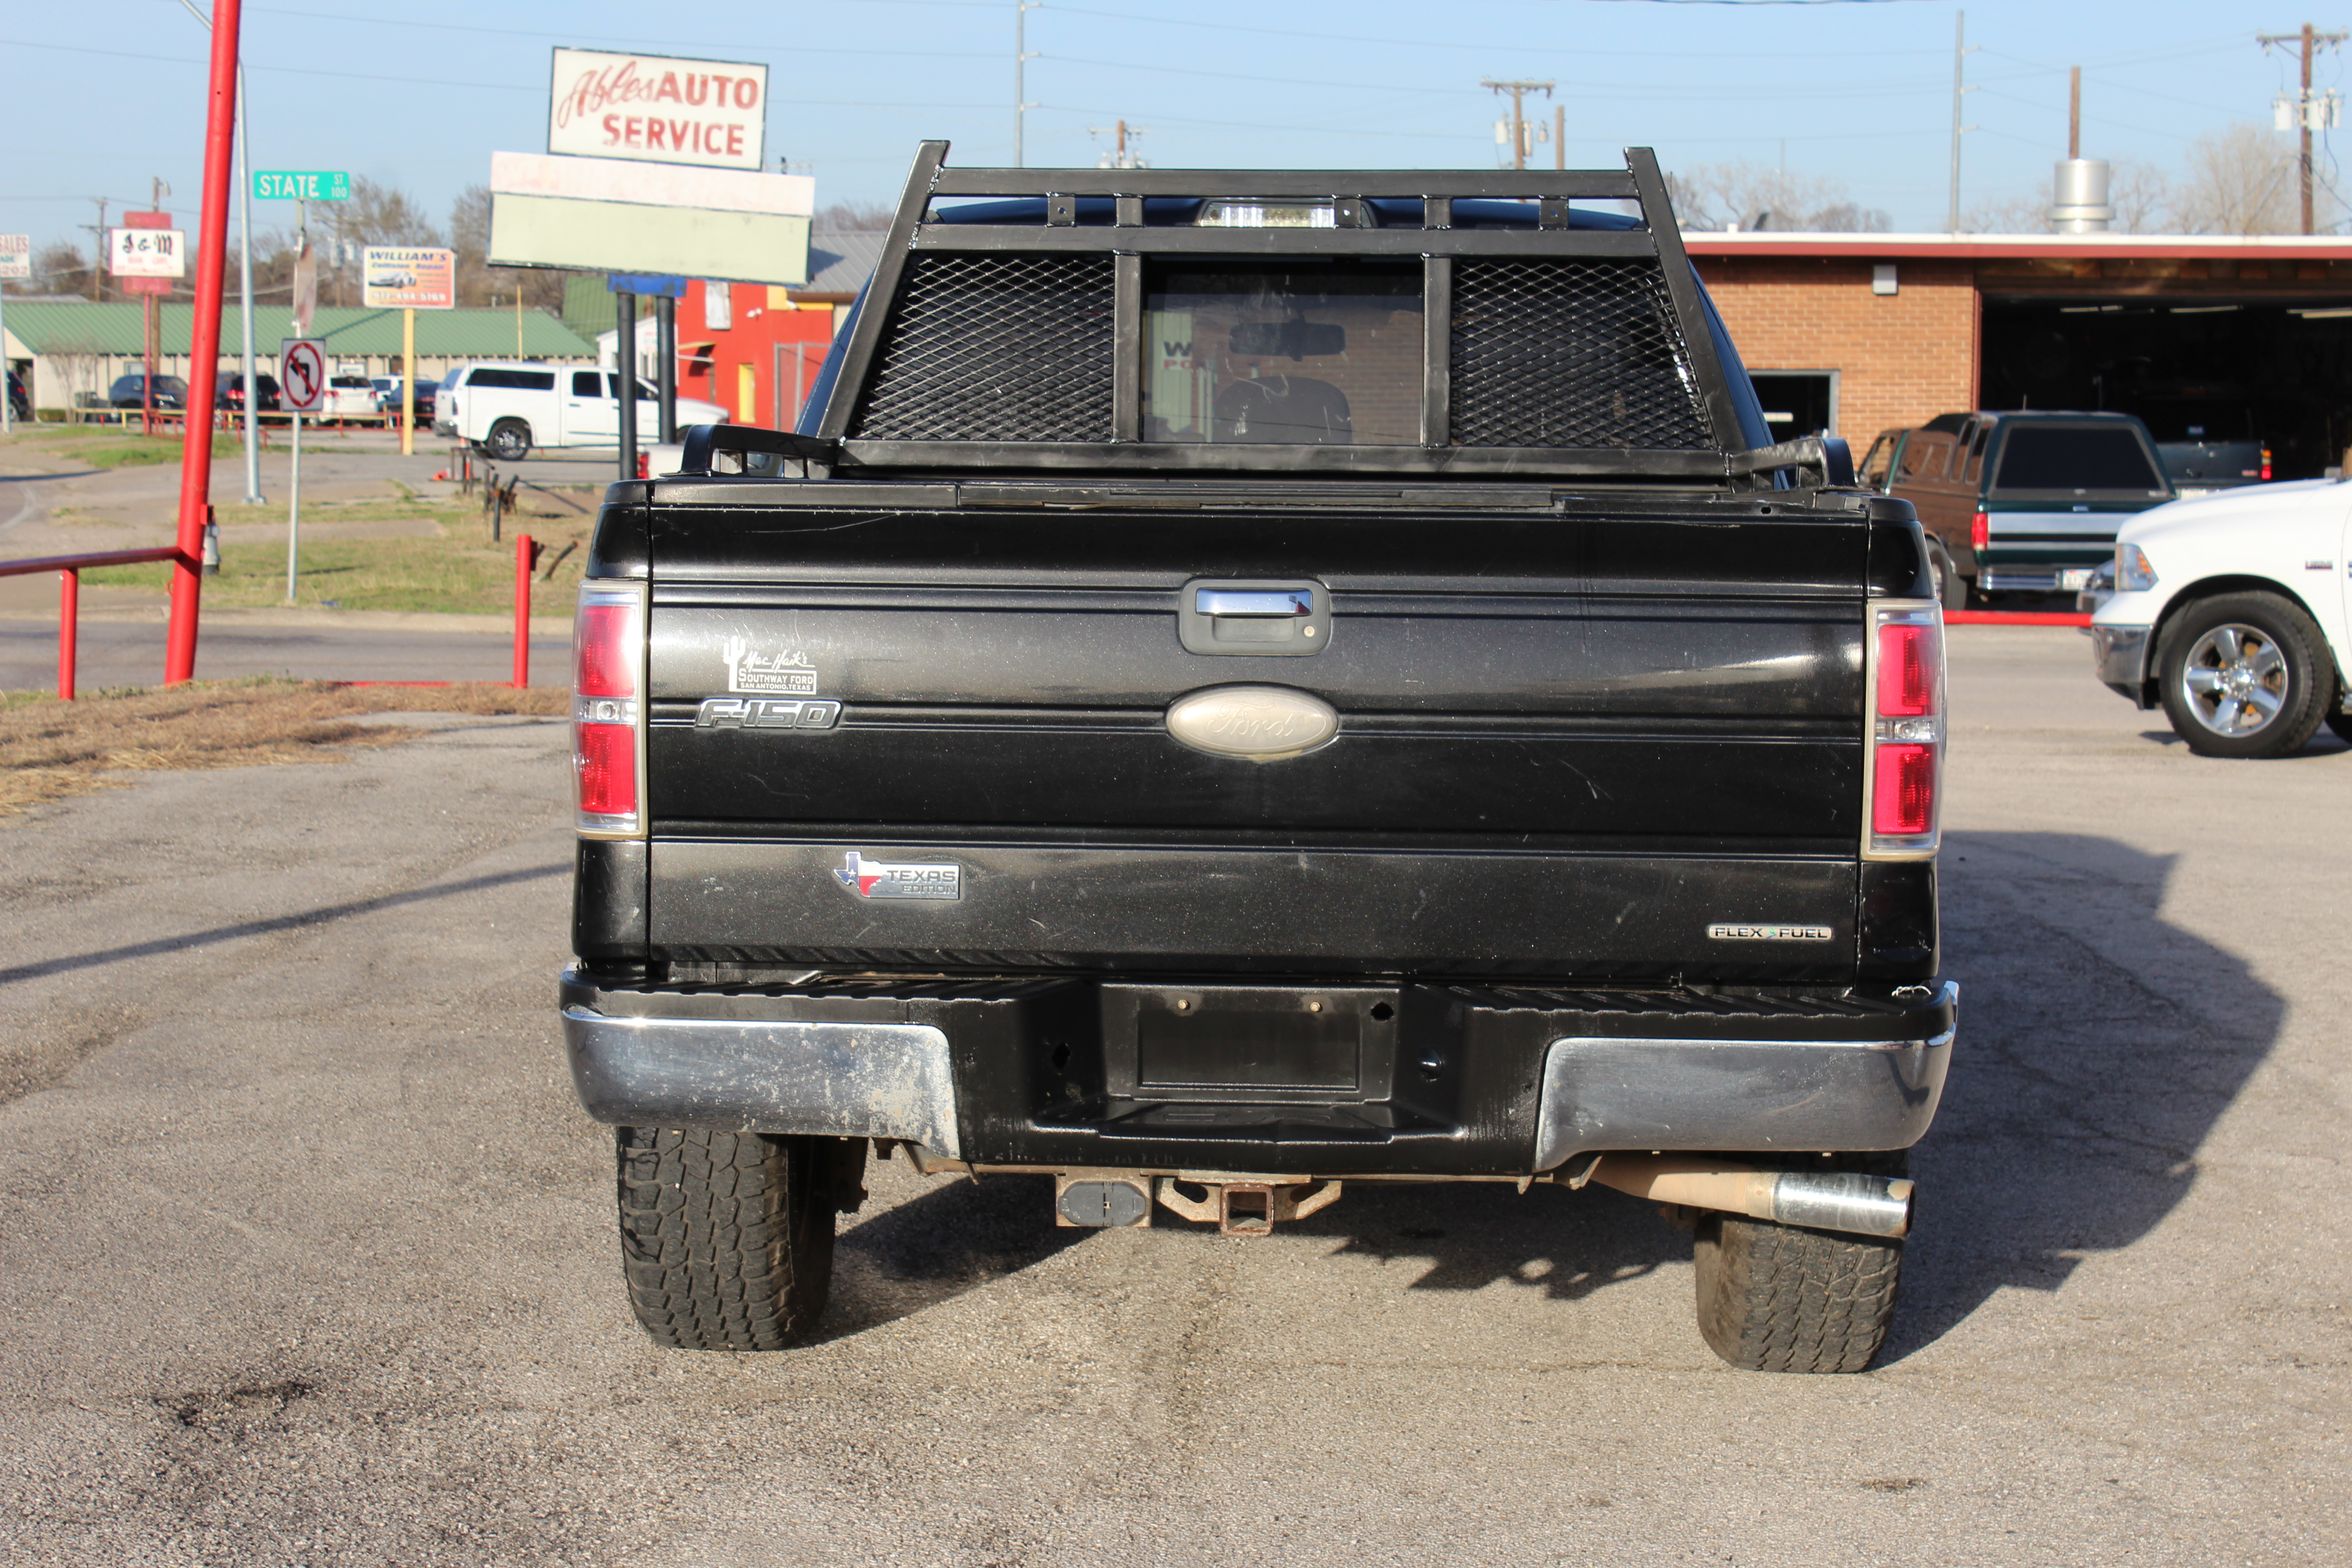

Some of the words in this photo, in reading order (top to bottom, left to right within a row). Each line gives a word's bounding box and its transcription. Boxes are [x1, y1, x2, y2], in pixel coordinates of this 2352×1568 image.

[653, 71, 758, 109] AUTO
[603, 113, 745, 156] SERVICE
[259, 174, 319, 197] STATE
[334, 173, 343, 185] ST
[331, 186, 347, 198] 100
[370, 251, 447, 261] WILLIAM'S
[743, 651, 772, 673] Mac
[772, 649, 815, 673] Haik's
[739, 668, 787, 684] SOUTHWAY
[791, 676, 813, 684] FORD
[1206, 701, 1296, 737] Ford
[887, 870, 956, 883] TEXAS
[902, 885, 956, 894] EDITION
[1715, 927, 1763, 937] FLEX
[1779, 928, 1828, 938] FUEL
